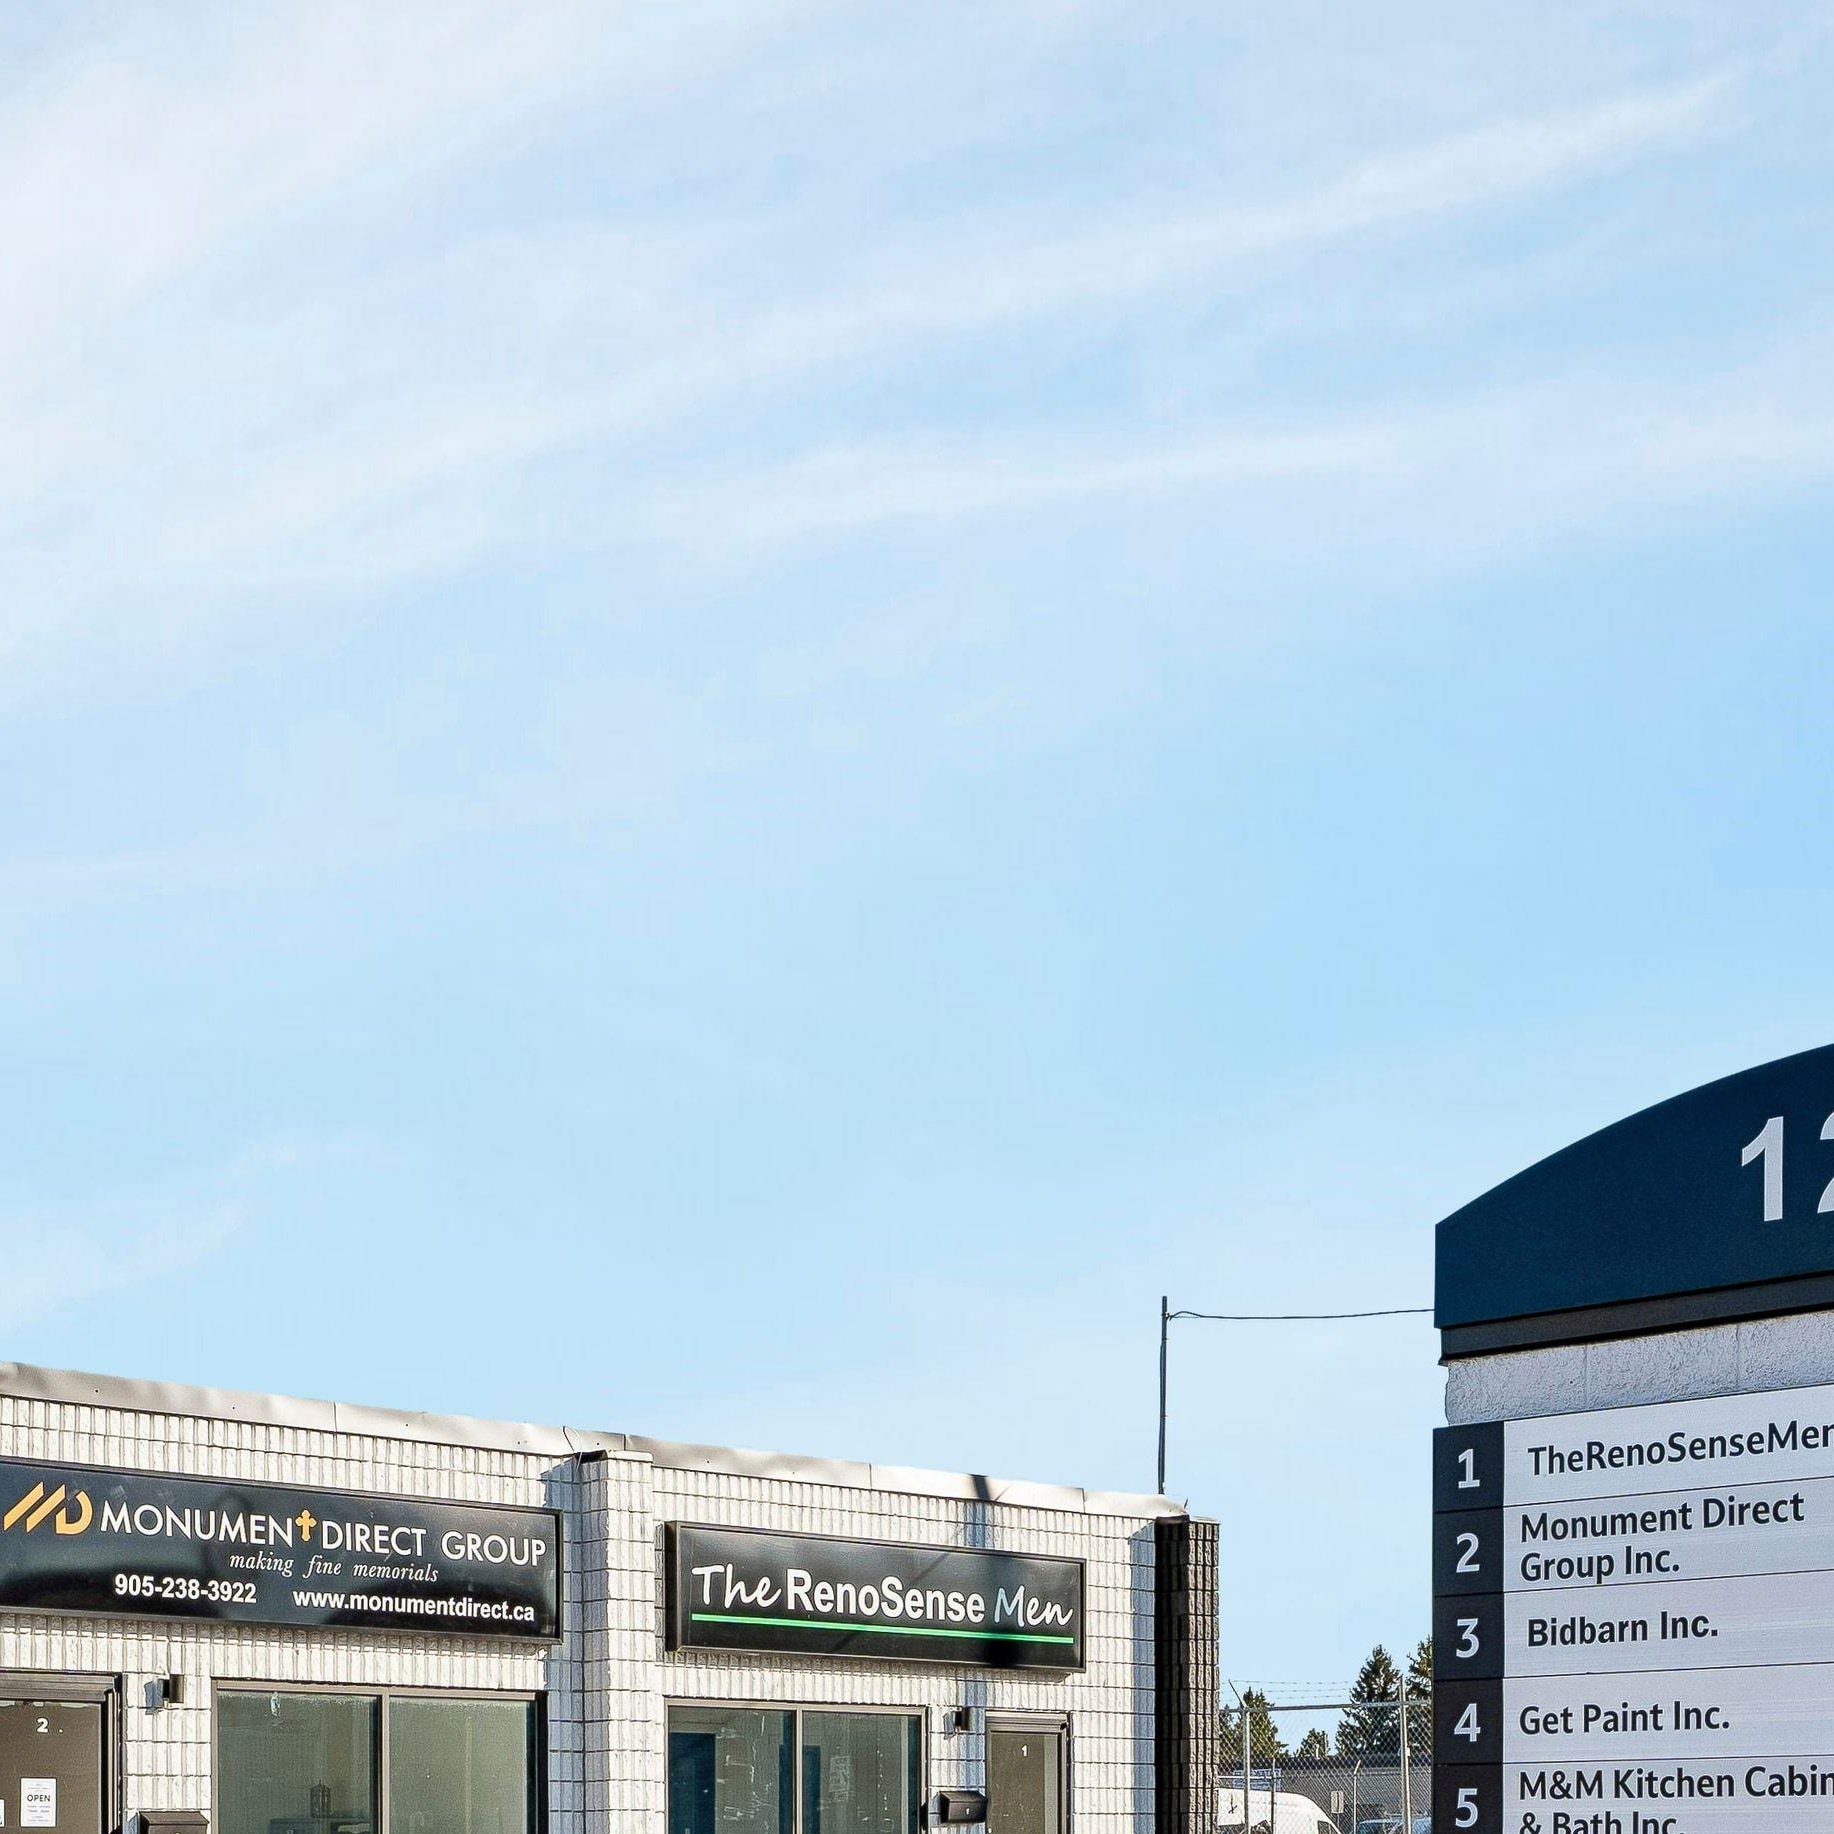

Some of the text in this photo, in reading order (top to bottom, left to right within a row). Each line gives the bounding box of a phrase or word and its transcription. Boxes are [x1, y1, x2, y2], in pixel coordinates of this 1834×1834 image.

[1458, 1448, 1481, 1489] 1
[1521, 1492, 1805, 1543] Monument Direct
[322, 1520, 427, 1560] DIRECT
[441, 1531, 546, 1567] GROUP
[1455, 1532, 1480, 1573] 2
[229, 1550, 439, 1583] making fine memorials
[1520, 1545, 1680, 1585] Group Inc.
[114, 1573, 535, 1622] 905-238-3922 www.monumentdirect.ca
[691, 1563, 1074, 1628] The RenoSense Men
[1455, 1617, 1480, 1659] 3
[1528, 1610, 1718, 1647] Bidbarn Inc.
[36, 1717, 49, 1733] 2
[1453, 1702, 1481, 1743] 4
[1519, 1700, 1730, 1736] Get Paint Inc.
[26, 1794, 51, 1803] OPEN
[1519, 1769, 1603, 1801] M&M
[1614, 1767, 1735, 1799] Kitchen
[1454, 1787, 1479, 1828] 5
